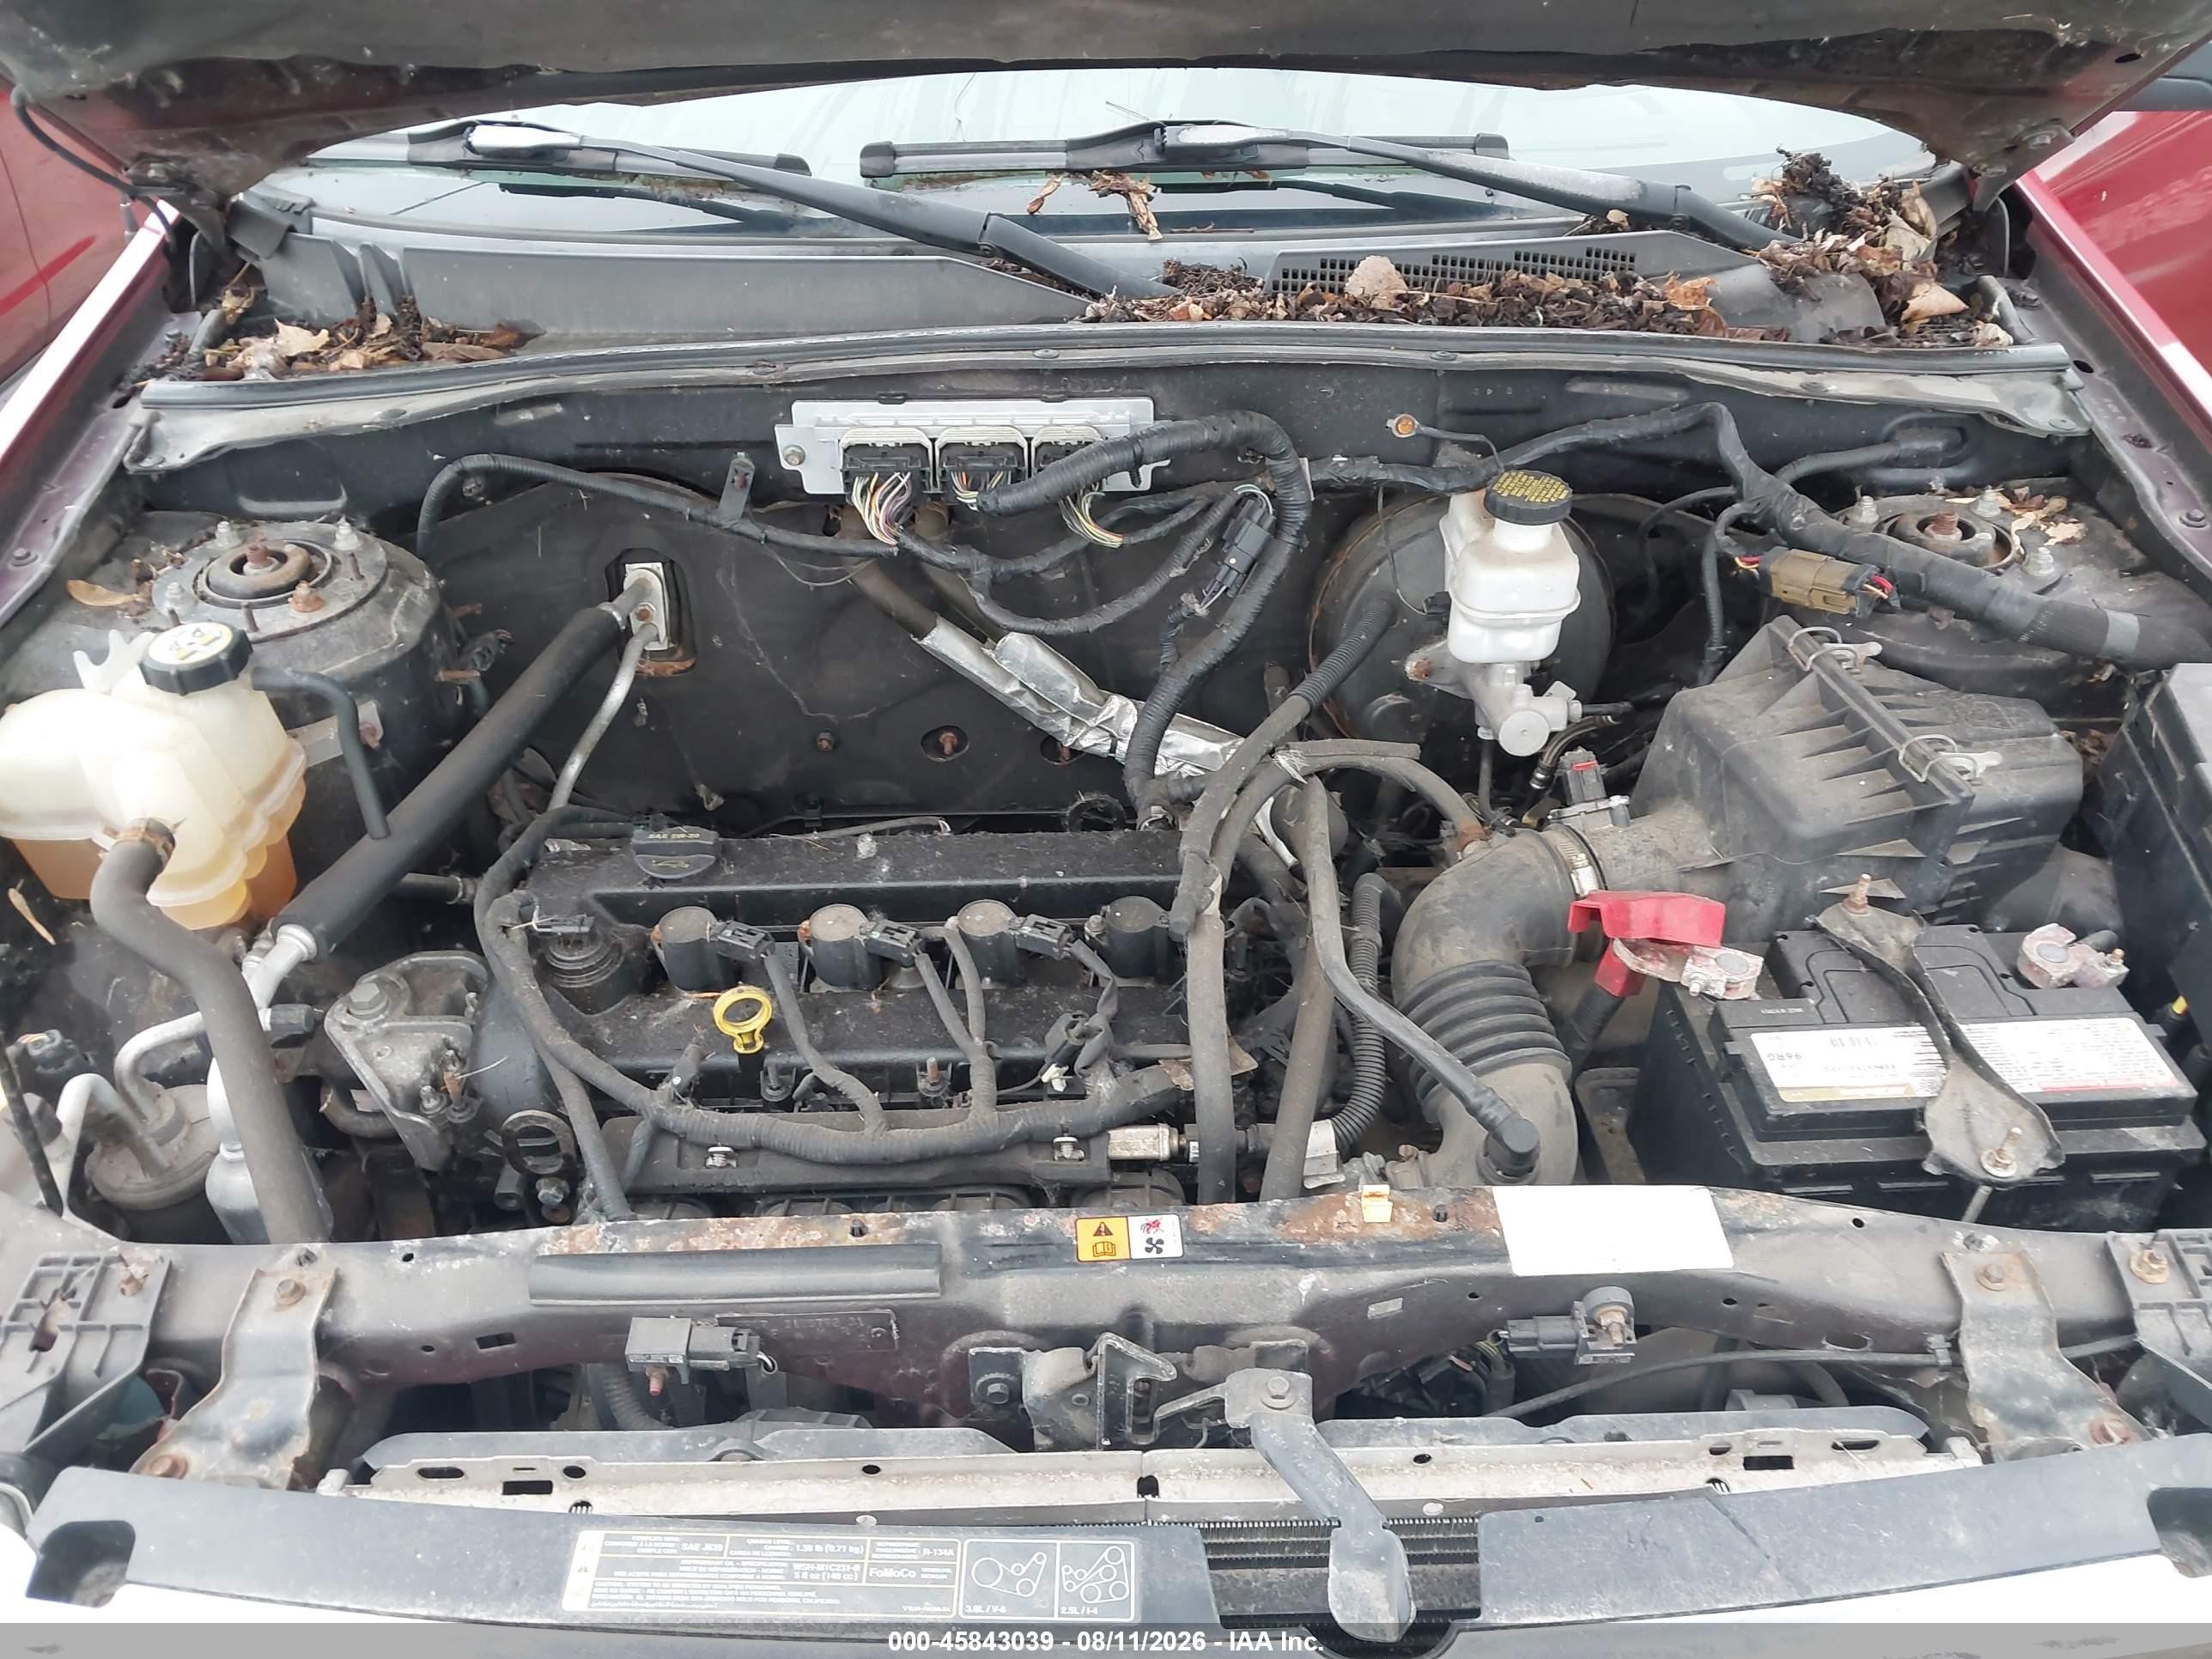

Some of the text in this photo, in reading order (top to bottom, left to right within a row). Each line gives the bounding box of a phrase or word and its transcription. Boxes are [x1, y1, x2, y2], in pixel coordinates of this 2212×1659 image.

[681, 1542, 701, 1551] SAE
[848, 1545, 864, 1555] kg)
[922, 1547, 955, 1556] R-134A
[842, 1572, 858, 1581] cc)
[869, 1567, 916, 1577] FoMoCo
[992, 1605, 1006, 1614] V-6
